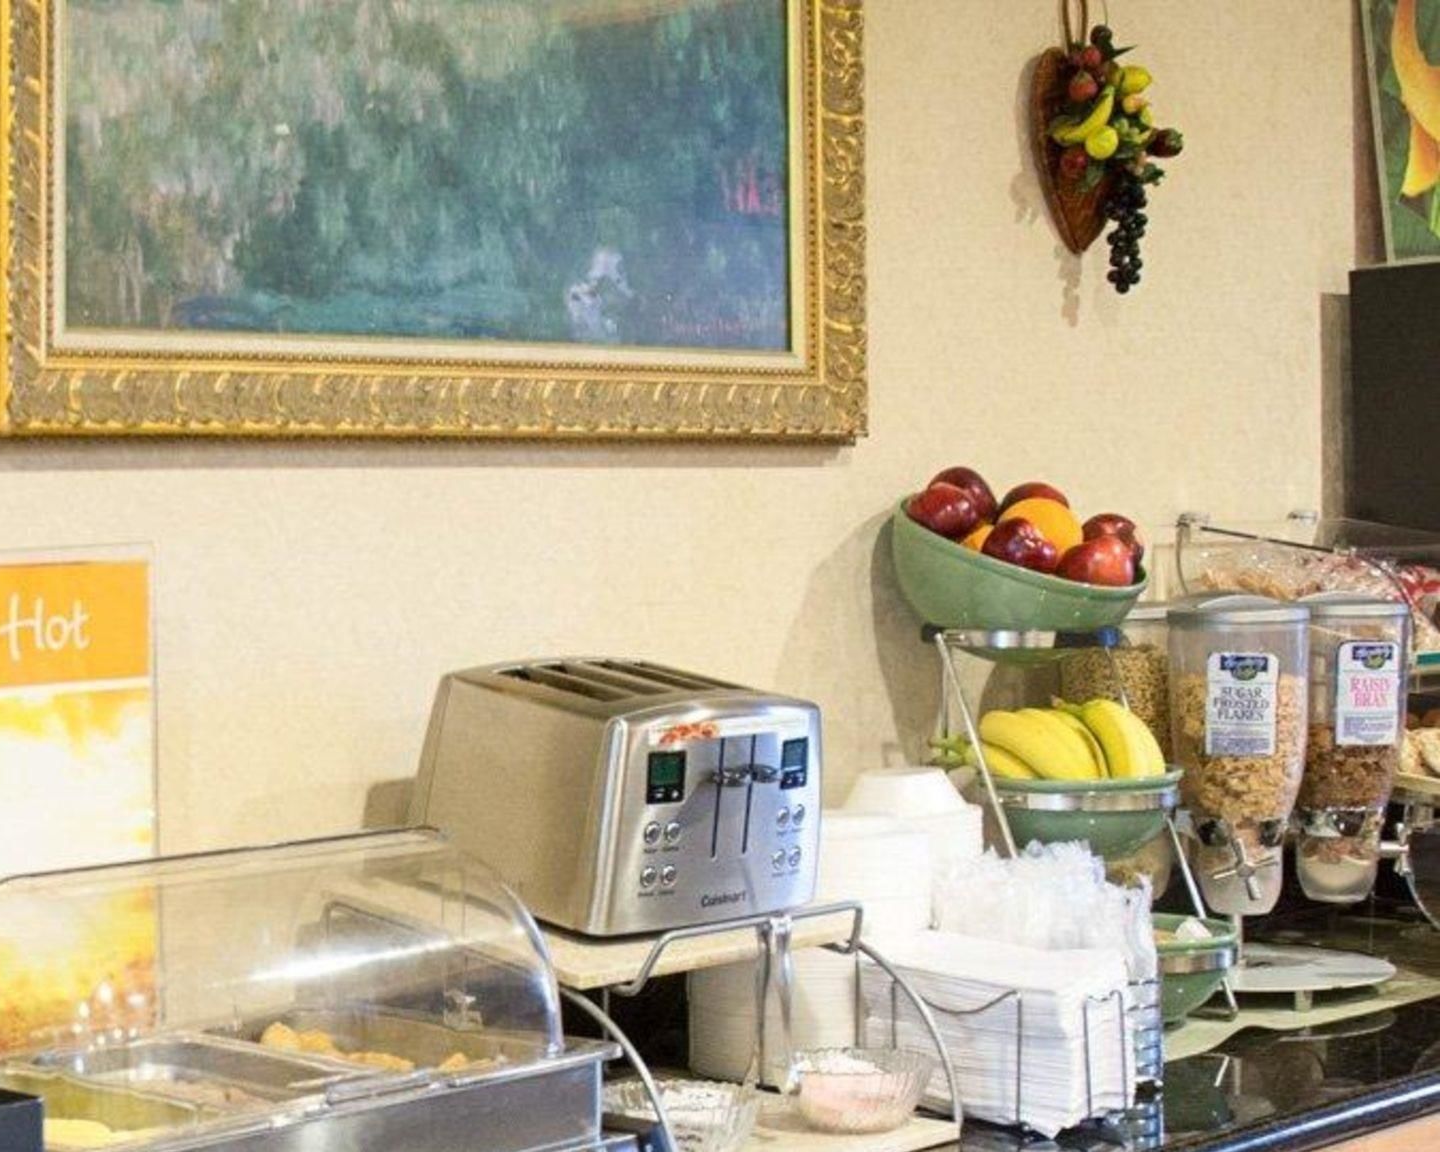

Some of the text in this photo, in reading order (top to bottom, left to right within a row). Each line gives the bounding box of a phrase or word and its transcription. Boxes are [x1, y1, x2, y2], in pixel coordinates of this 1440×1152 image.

[1221, 686, 1263, 698] SUGAR
[1213, 697, 1270, 709] FROSTED
[1217, 709, 1264, 721] FLAKES
[701, 891, 747, 908] Cuisinart
